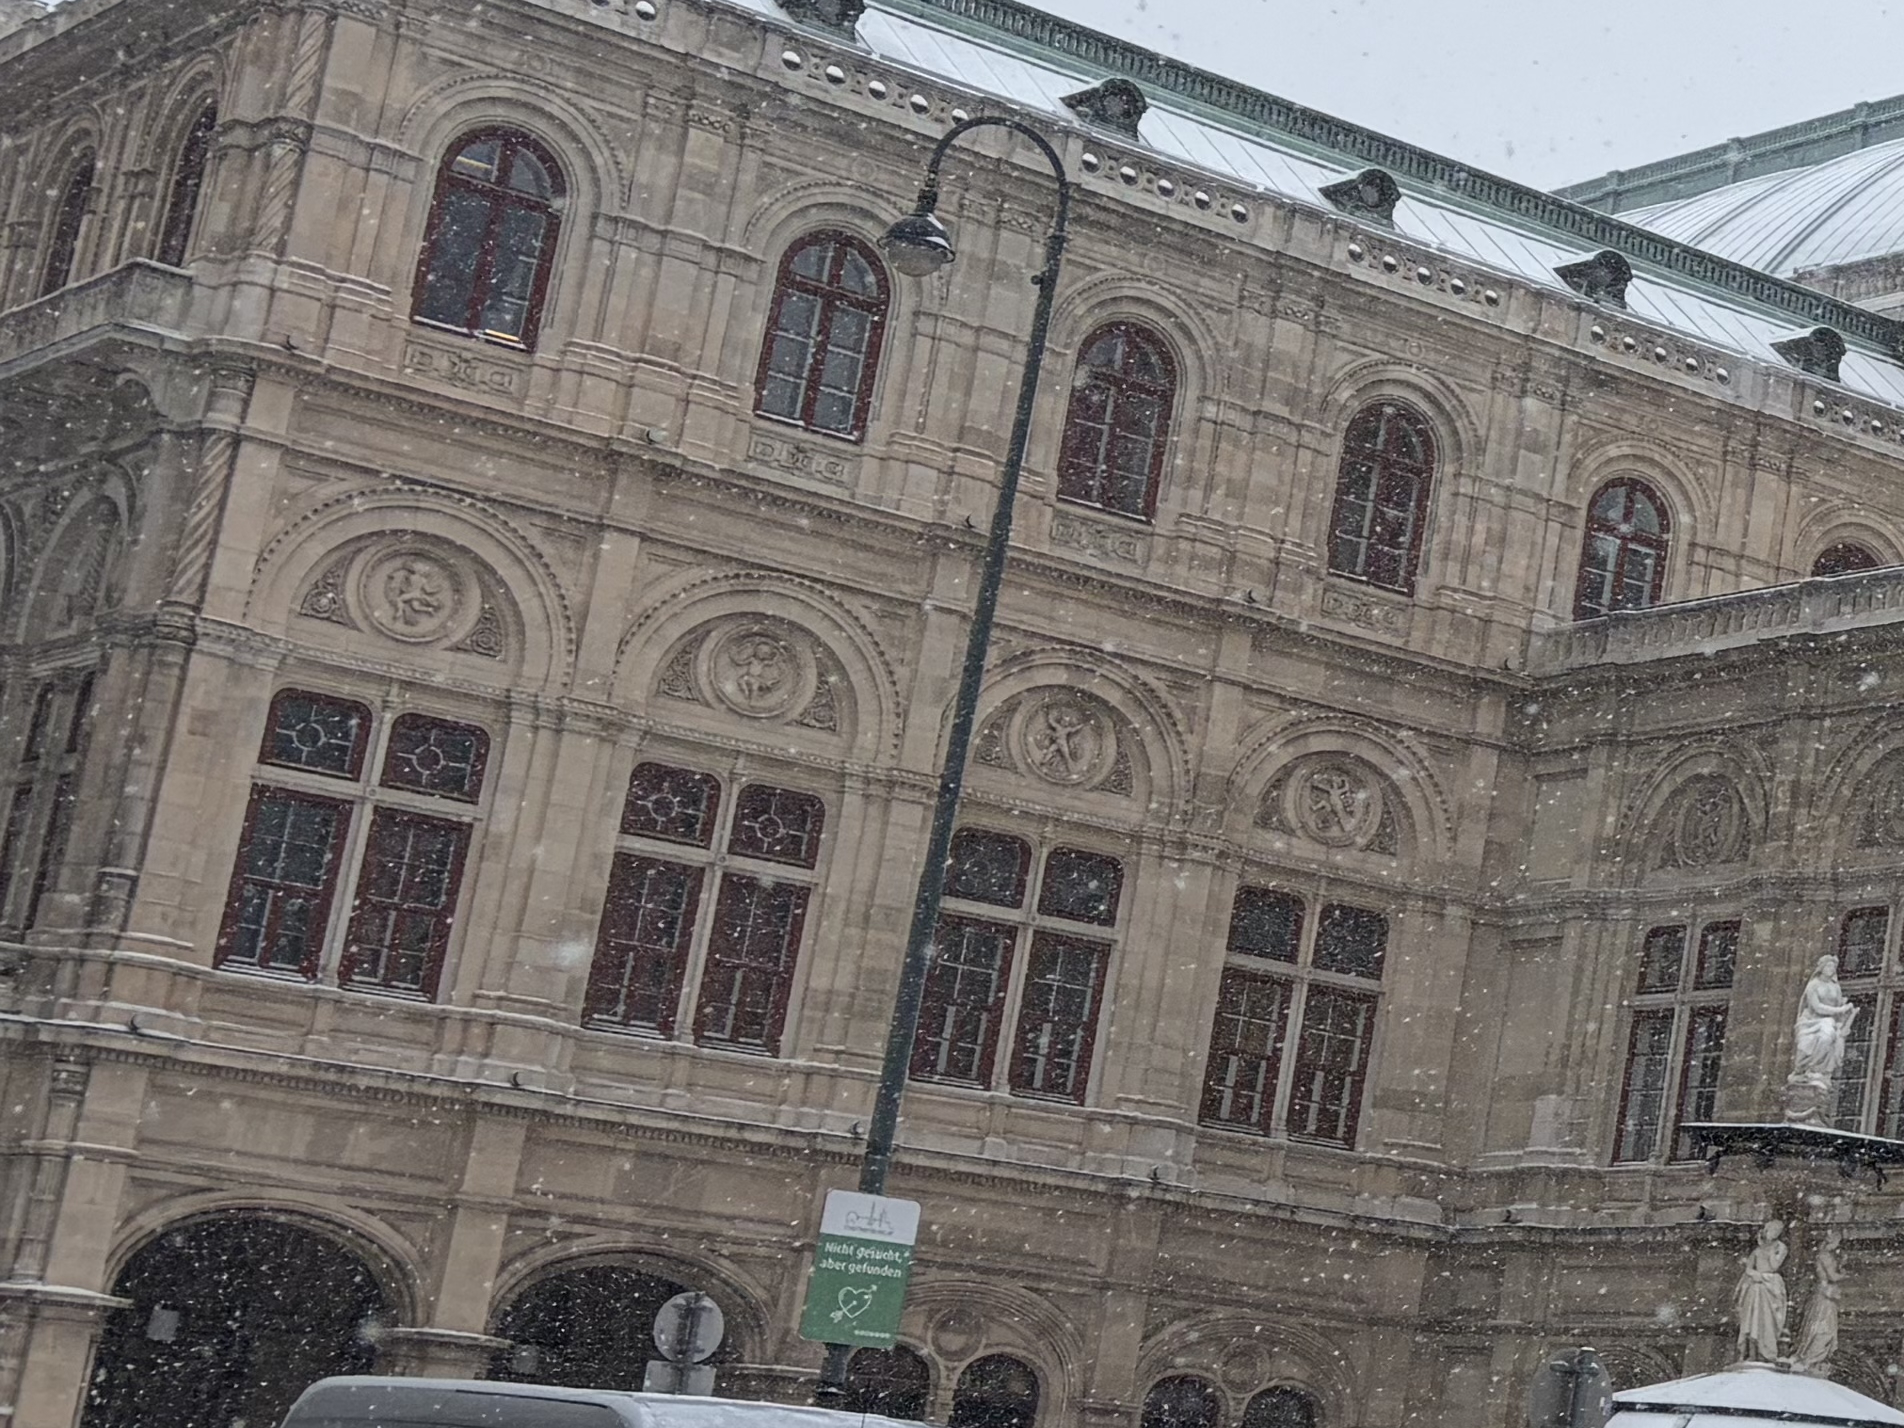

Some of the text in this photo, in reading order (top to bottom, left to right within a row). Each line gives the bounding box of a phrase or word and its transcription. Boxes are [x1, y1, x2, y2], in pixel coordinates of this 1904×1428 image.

[824, 1242, 902, 1262] Nicht gesucht,
[819, 1257, 902, 1278] aber gefunden
